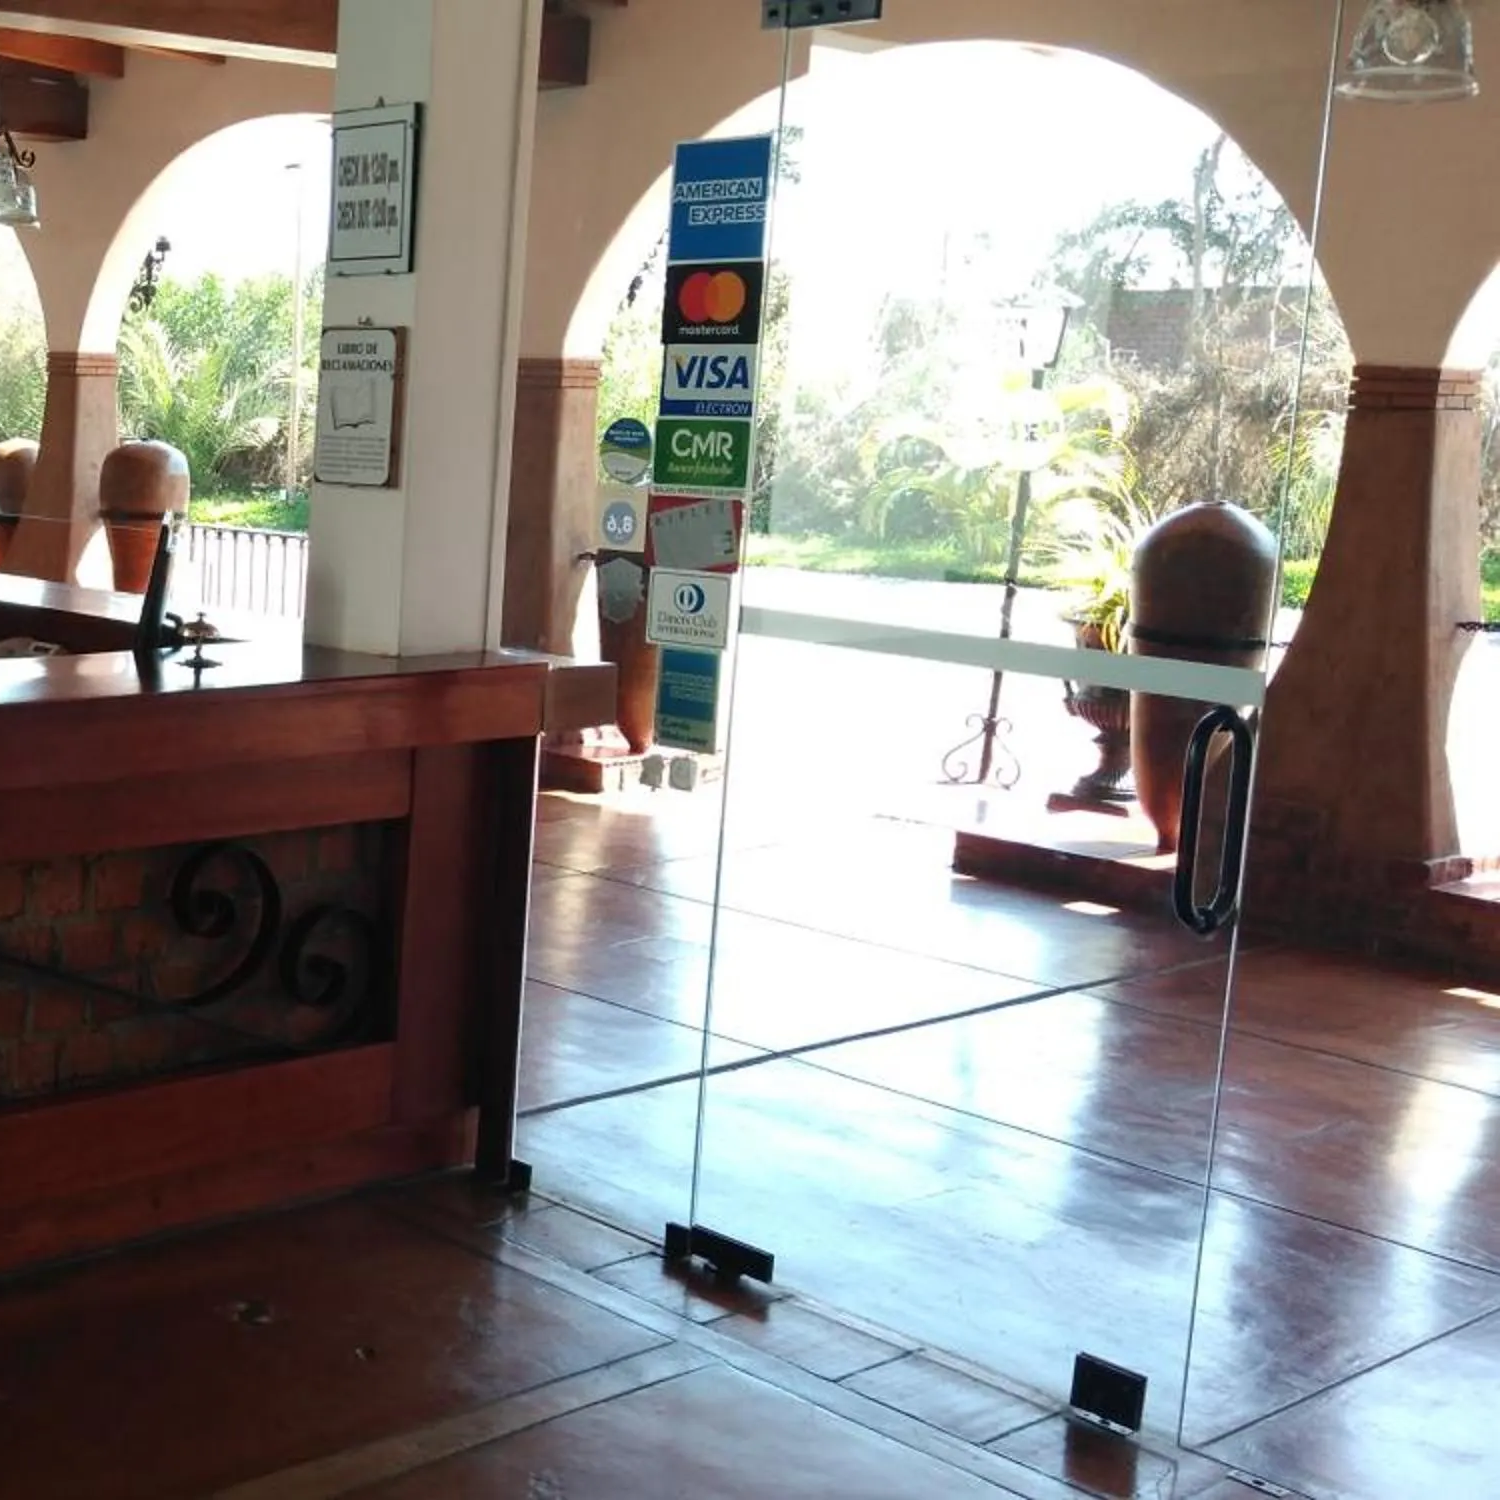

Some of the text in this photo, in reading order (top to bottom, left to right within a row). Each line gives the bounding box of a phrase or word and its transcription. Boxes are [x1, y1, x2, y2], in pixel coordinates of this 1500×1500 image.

[338, 155, 360, 186] CHECK
[675, 178, 762, 201] AMERICAN
[337, 200, 357, 231] CHECK
[689, 203, 766, 225] EXPRESS
[337, 342, 378, 354] LIBRO DE
[321, 359, 393, 372] RECLAMACIONES
[675, 355, 749, 390] VISA
[695, 400, 749, 416] ELECTRON
[671, 428, 733, 461] CMR
[656, 611, 717, 629] Diners Club
